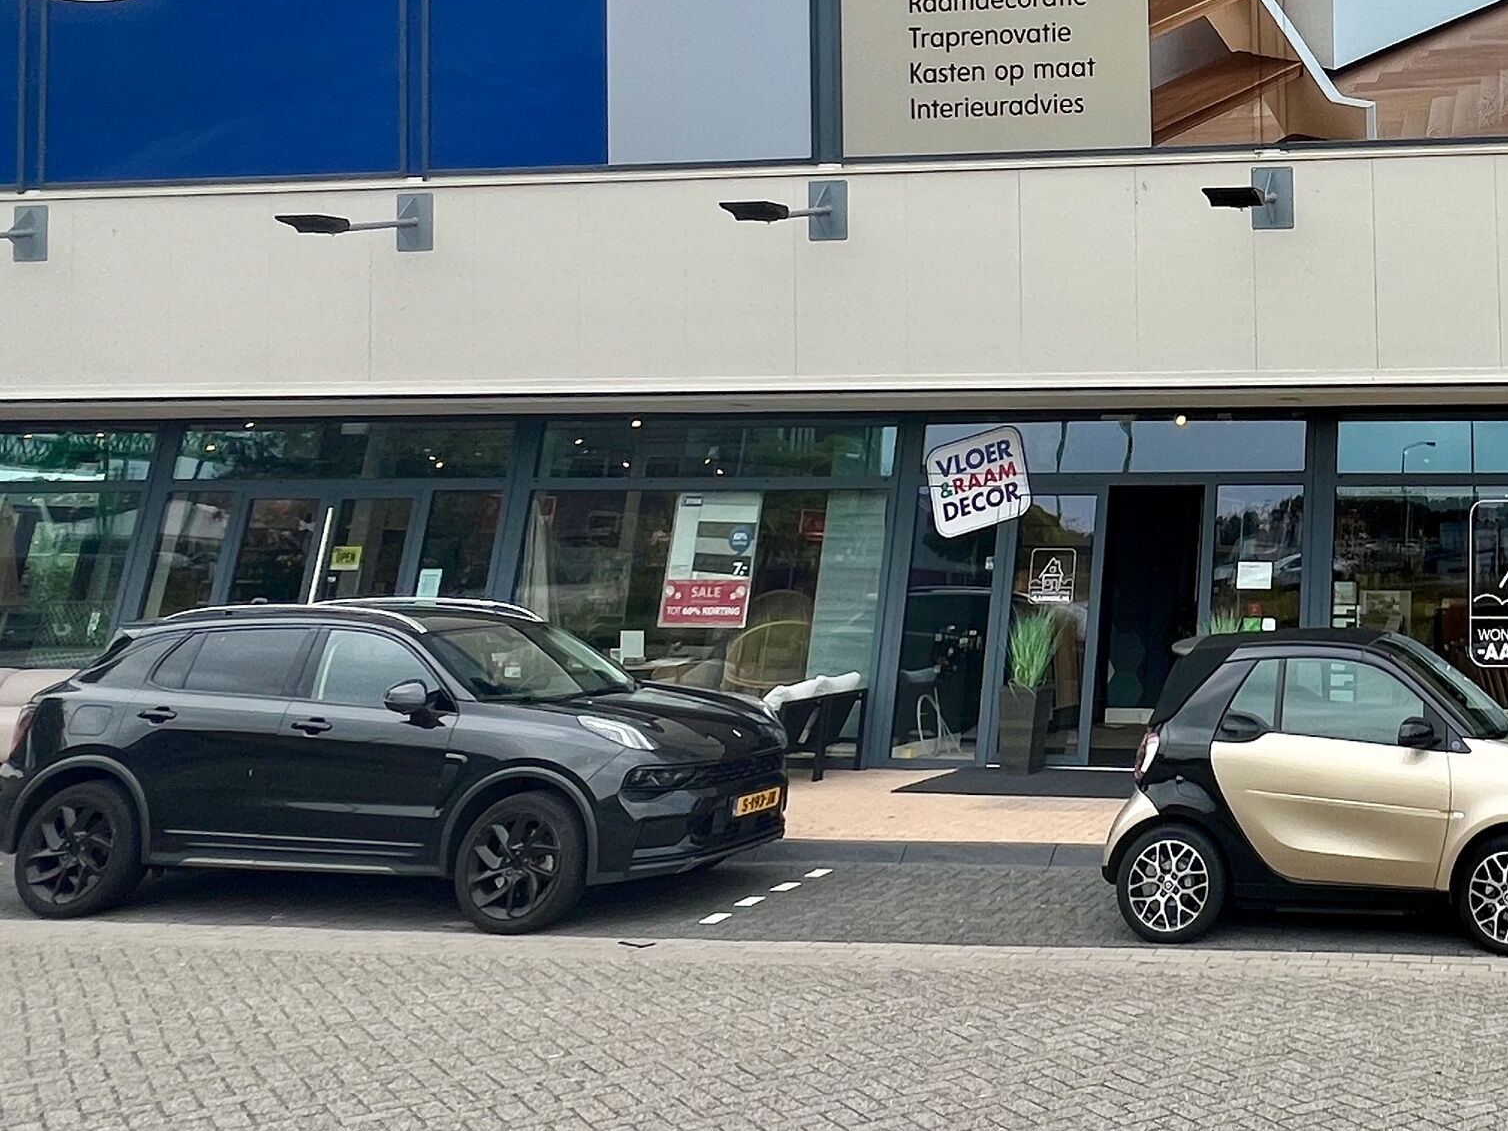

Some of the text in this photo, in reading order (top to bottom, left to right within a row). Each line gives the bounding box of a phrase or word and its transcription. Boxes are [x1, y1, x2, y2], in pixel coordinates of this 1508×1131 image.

[908, 22, 1072, 53] Traprenovatie
[909, 57, 1096, 86] Kasten op maat
[910, 93, 1085, 120] Interieuradvies
[935, 439, 1013, 477] VLOER
[940, 461, 1018, 499] &RAAM
[943, 481, 1021, 522] DECOR
[691, 586, 722, 599] SALE
[666, 606, 681, 616] TOT
